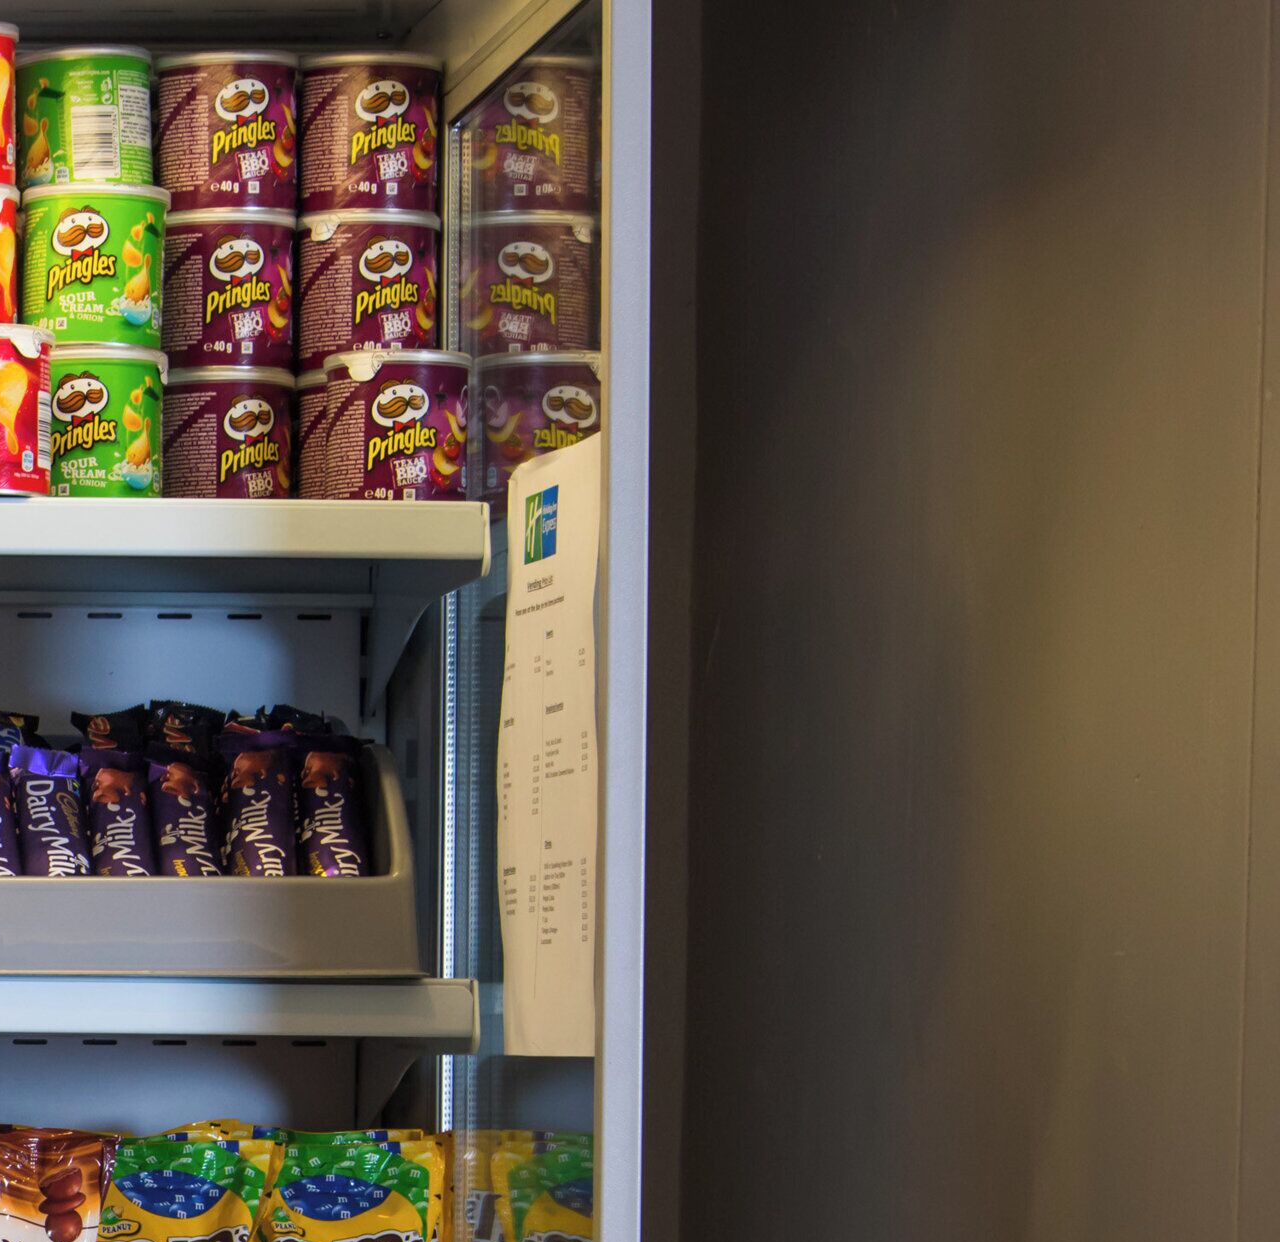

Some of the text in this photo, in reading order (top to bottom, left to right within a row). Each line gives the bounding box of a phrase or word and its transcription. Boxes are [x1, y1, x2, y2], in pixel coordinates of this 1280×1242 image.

[212, 119, 276, 163] Pringles
[351, 120, 416, 165] Pringles
[238, 151, 266, 162] TEXAS
[377, 151, 406, 162] TEXAS
[240, 157, 269, 174] BBQ
[379, 157, 407, 174] BBQ
[59, 291, 95, 303] SOUR
[206, 282, 270, 324] Pringles
[60, 302, 104, 313] CREAM
[368, 424, 436, 470] Pringles
[241, 791, 273, 843] Milk
